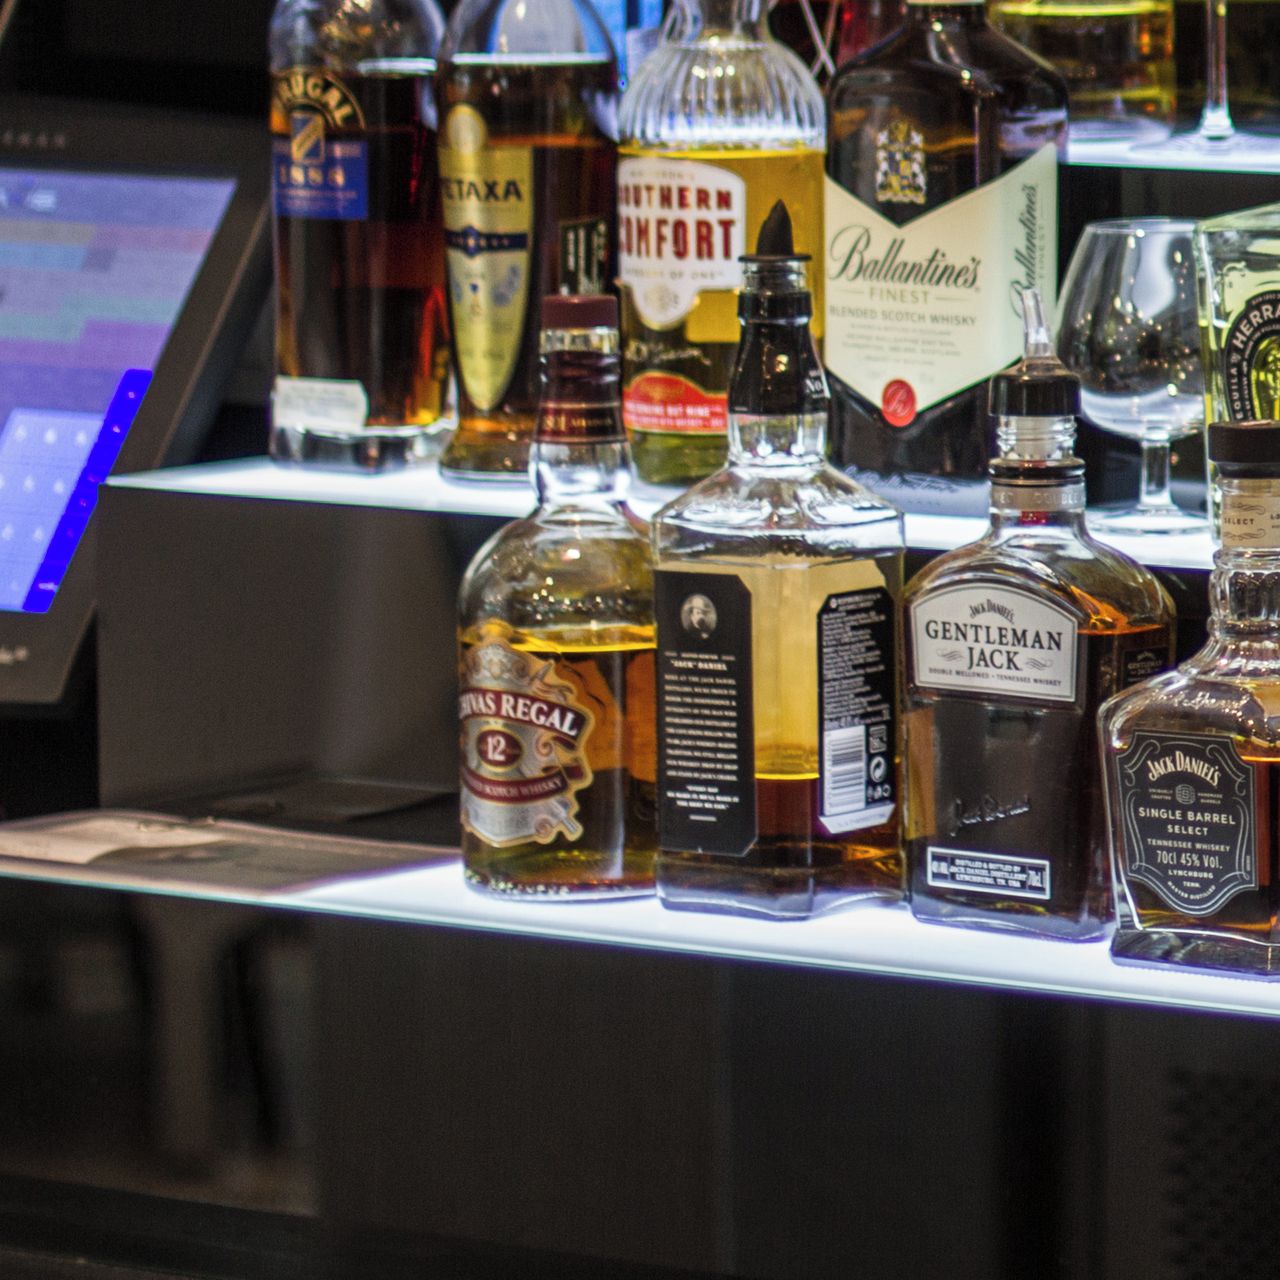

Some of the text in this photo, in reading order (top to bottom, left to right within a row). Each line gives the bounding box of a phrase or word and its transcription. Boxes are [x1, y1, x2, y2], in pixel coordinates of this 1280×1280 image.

[829, 223, 980, 292] Ballantine's
[869, 287, 930, 305] FINEST
[829, 304, 977, 327] BLENDED SCOTCH WHISKY
[925, 619, 1063, 652] GENTLEMAN
[967, 647, 1022, 671] JACK
[928, 667, 1062, 687] DOUBLE MELLOWED TENNESSEE WHISKEY
[500, 695, 578, 737] REGAL
[486, 735, 507, 761] 12
[1147, 750, 1222, 787] JACK DANIEL'S
[1138, 807, 1237, 825] SINGLE BARREL
[1167, 824, 1209, 836] SELECT
[1146, 838, 1231, 853] TENNESSEE WHISKEY
[1156, 850, 1223, 869] 70cl 45% Vol.
[1168, 869, 1214, 879] LYNCHBURG
